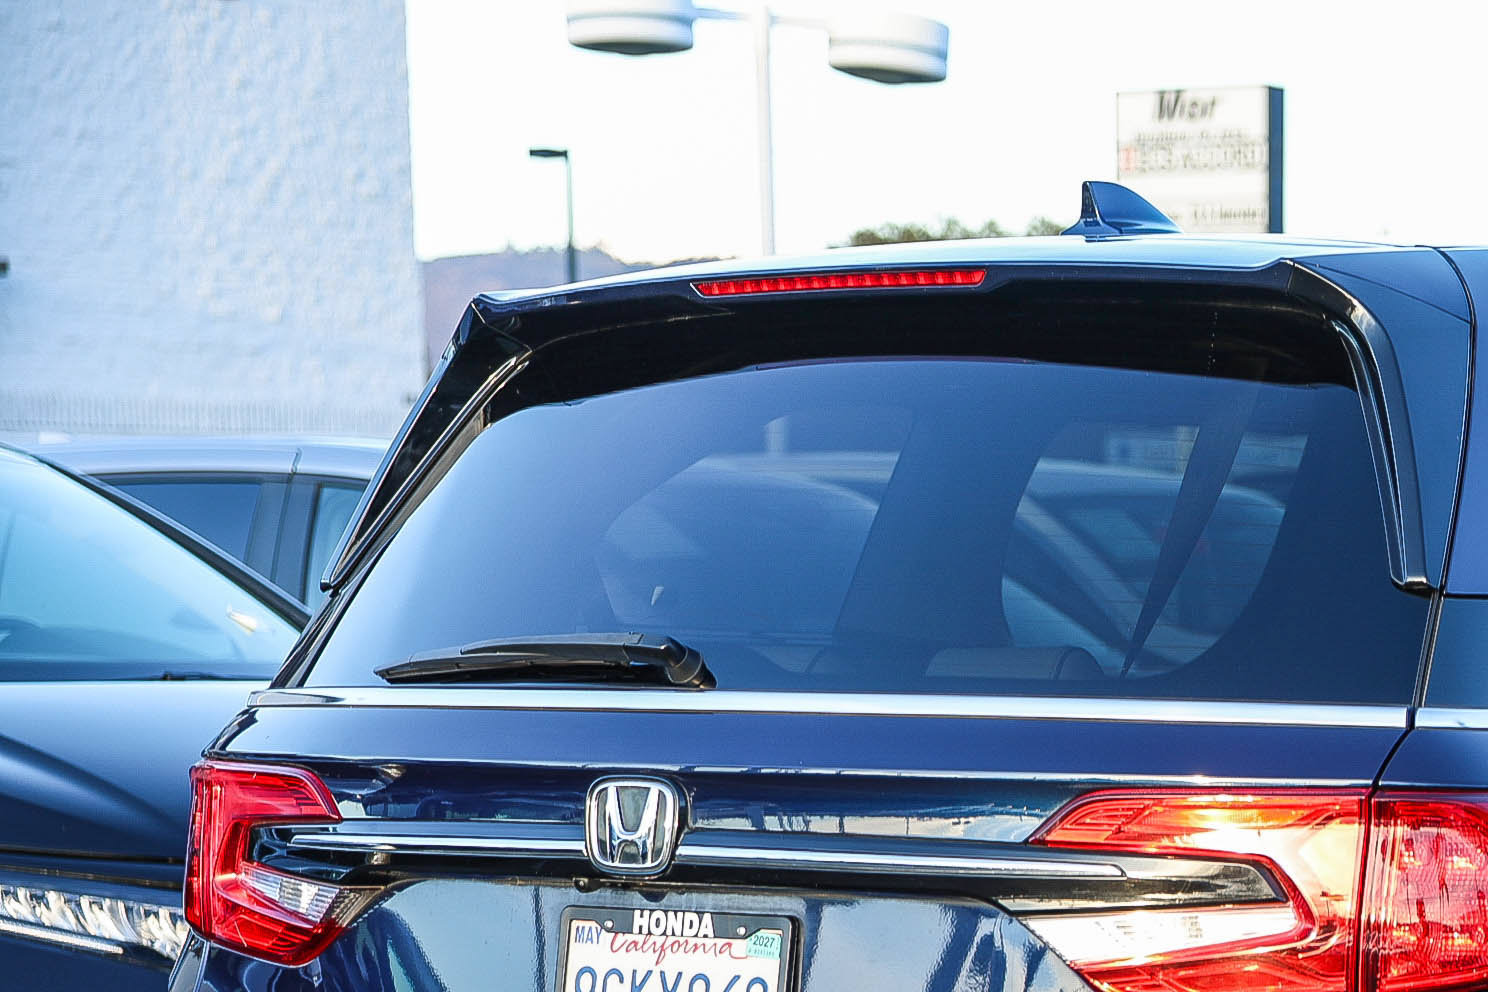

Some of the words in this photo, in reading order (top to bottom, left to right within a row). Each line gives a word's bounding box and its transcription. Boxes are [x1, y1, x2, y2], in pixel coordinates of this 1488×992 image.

[574, 925, 603, 945] MAY
[632, 909, 716, 939] HONDA
[608, 932, 748, 966] California
[753, 935, 775, 949] 2027
